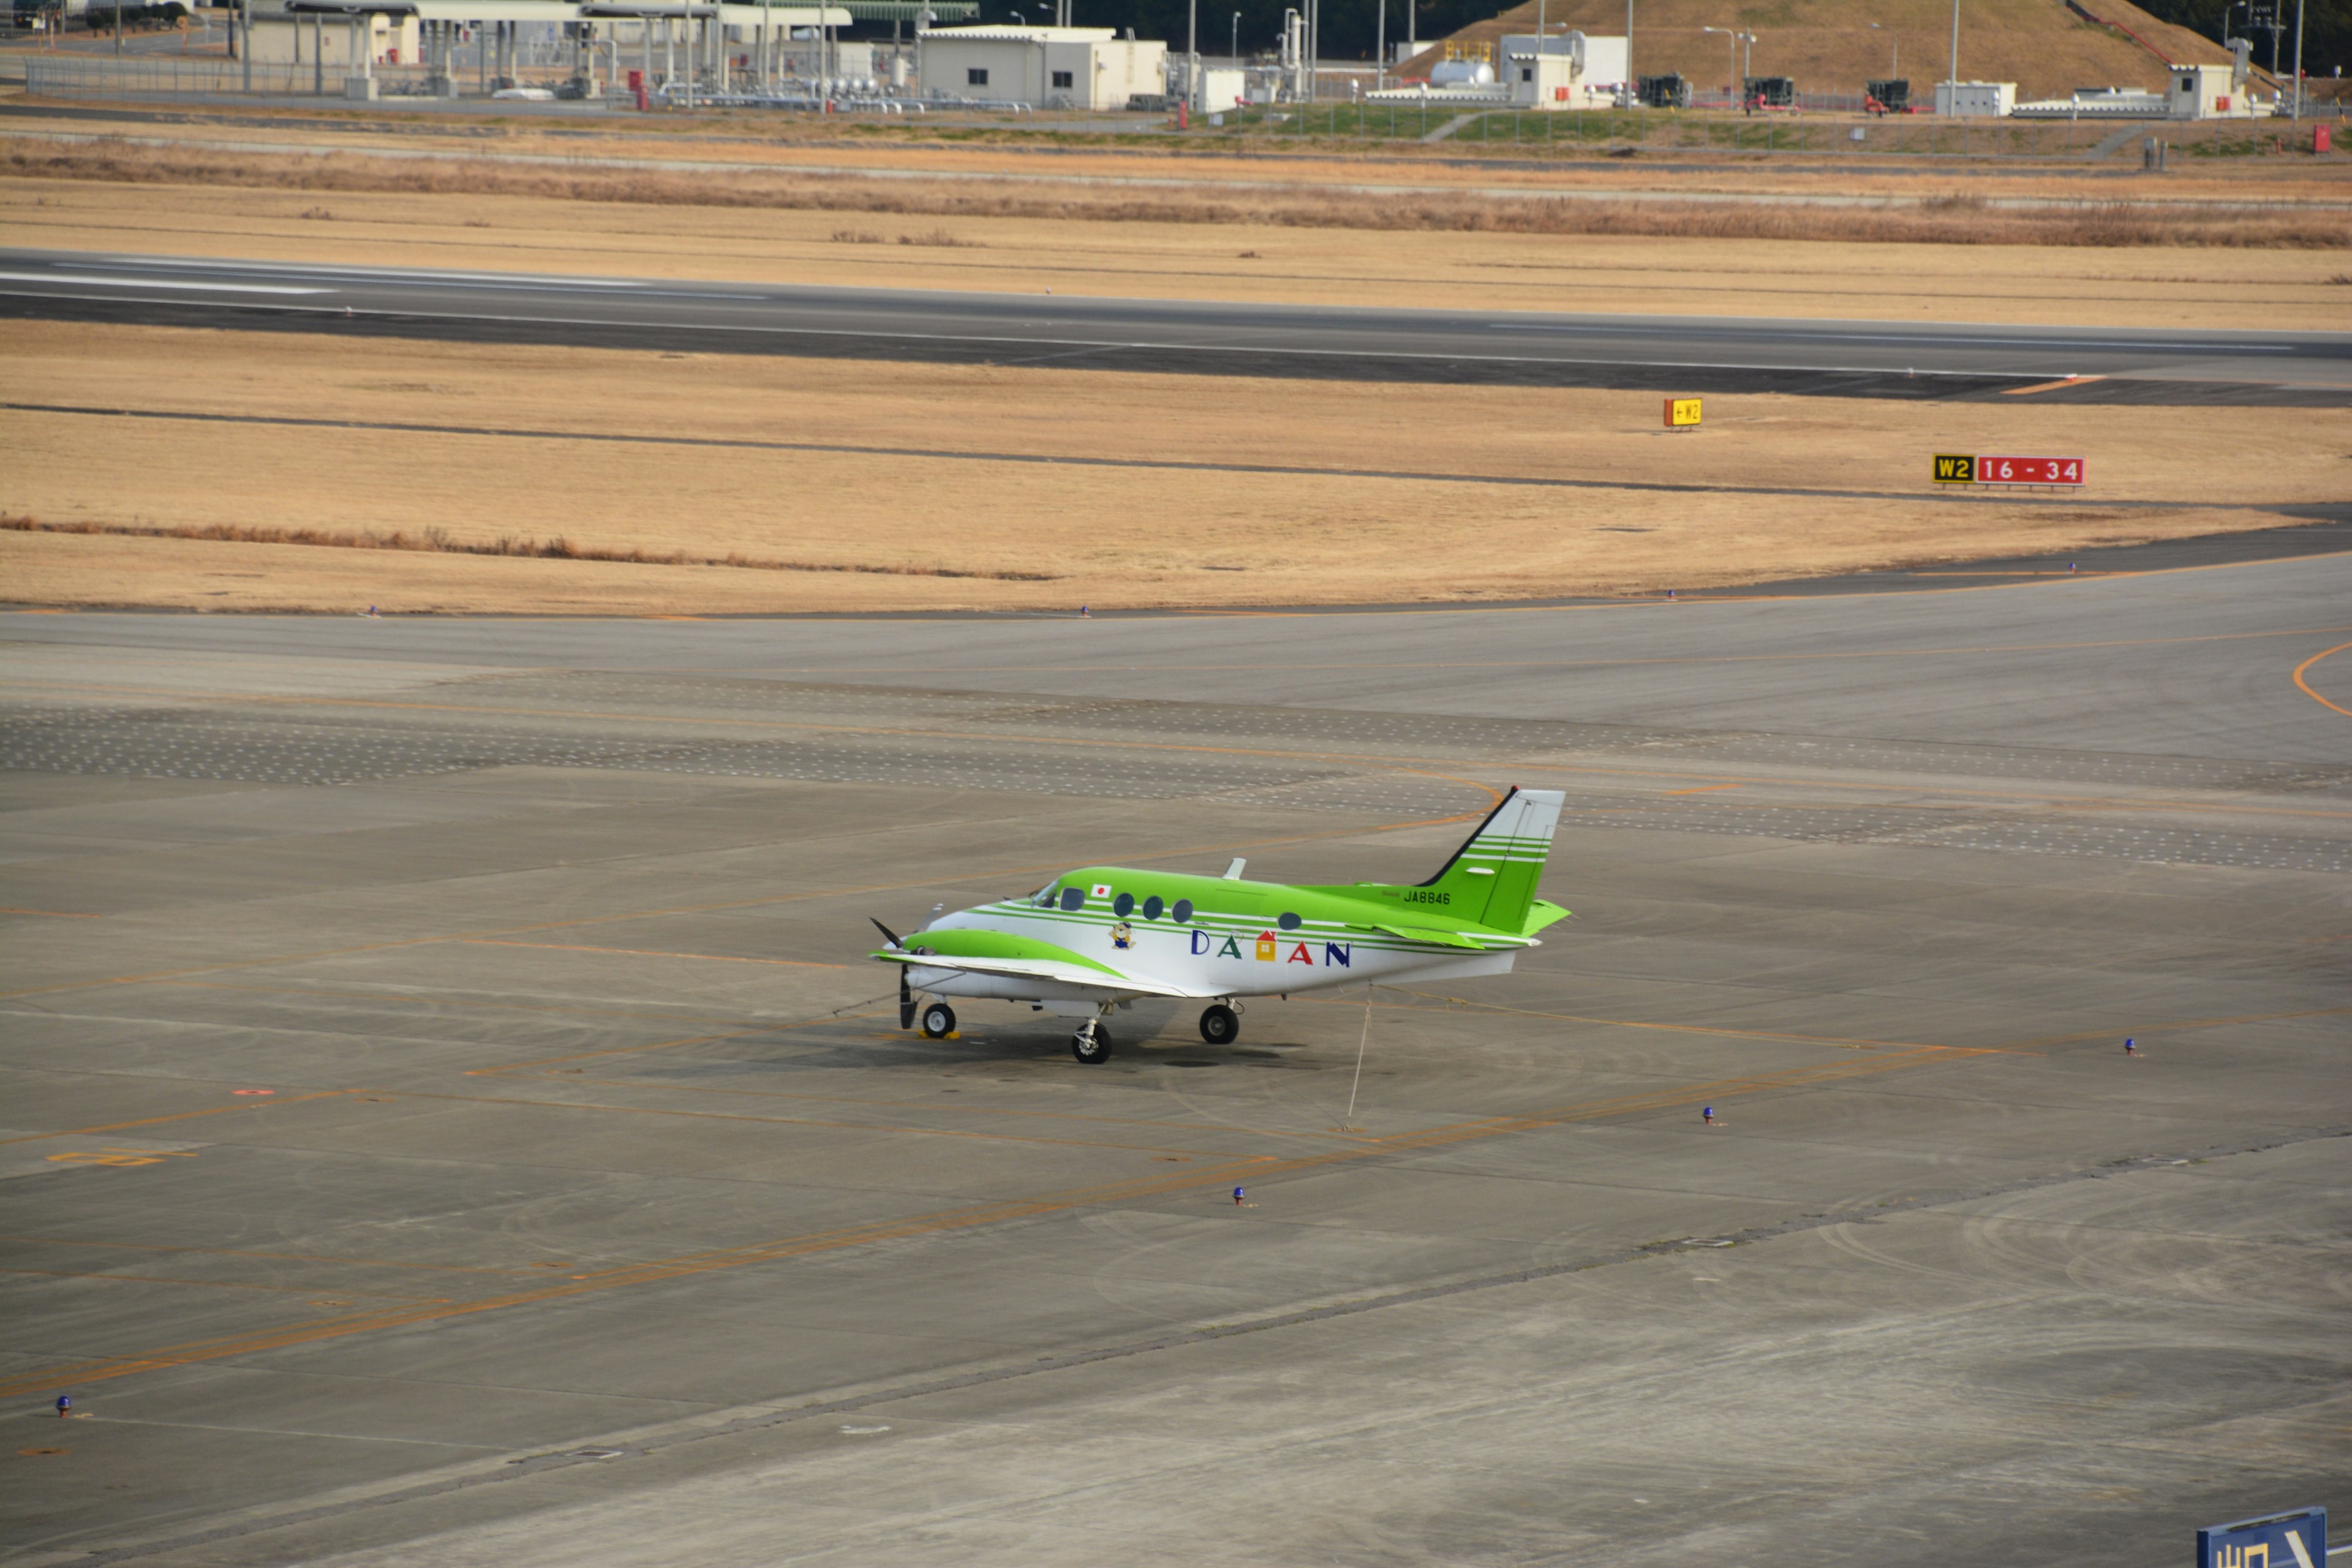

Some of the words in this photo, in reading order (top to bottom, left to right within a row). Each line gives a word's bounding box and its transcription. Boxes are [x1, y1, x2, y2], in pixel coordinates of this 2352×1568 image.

[1685, 404, 1698, 420] W2
[1938, 459, 1969, 478] W2
[1404, 891, 1451, 905] JA8846
